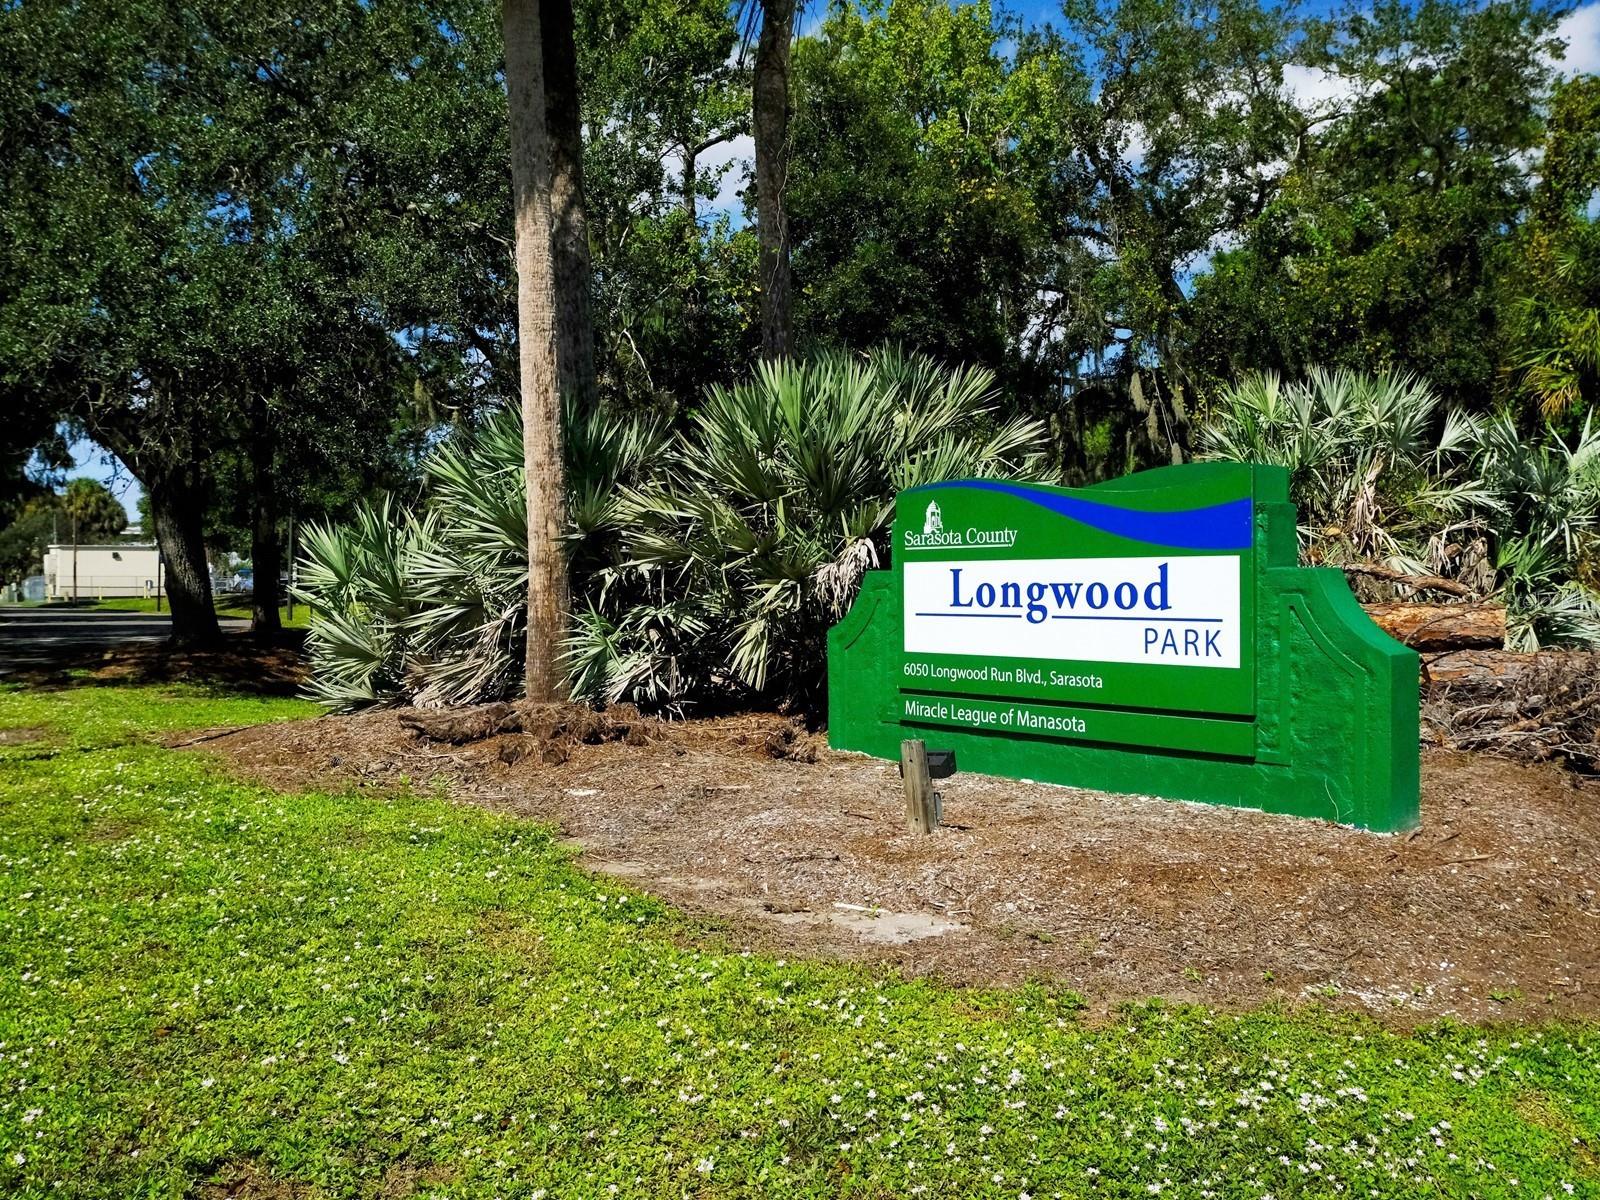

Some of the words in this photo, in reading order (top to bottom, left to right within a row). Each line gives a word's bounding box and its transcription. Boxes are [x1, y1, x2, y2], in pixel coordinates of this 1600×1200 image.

[904, 530, 962, 546] Sarasota
[966, 527, 1018, 547] County
[949, 562, 1173, 625] Longwood
[1144, 627, 1222, 658] PARK
[903, 662, 929, 677] 6050
[931, 665, 988, 682] Longwood
[990, 667, 1013, 682] Run
[1015, 668, 1047, 687] Blvd.,
[1050, 670, 1103, 688] Sarasota
[905, 700, 948, 719] Miracle
[951, 704, 997, 726] League
[1000, 708, 1014, 725] of
[1017, 709, 1086, 733] Manasota
